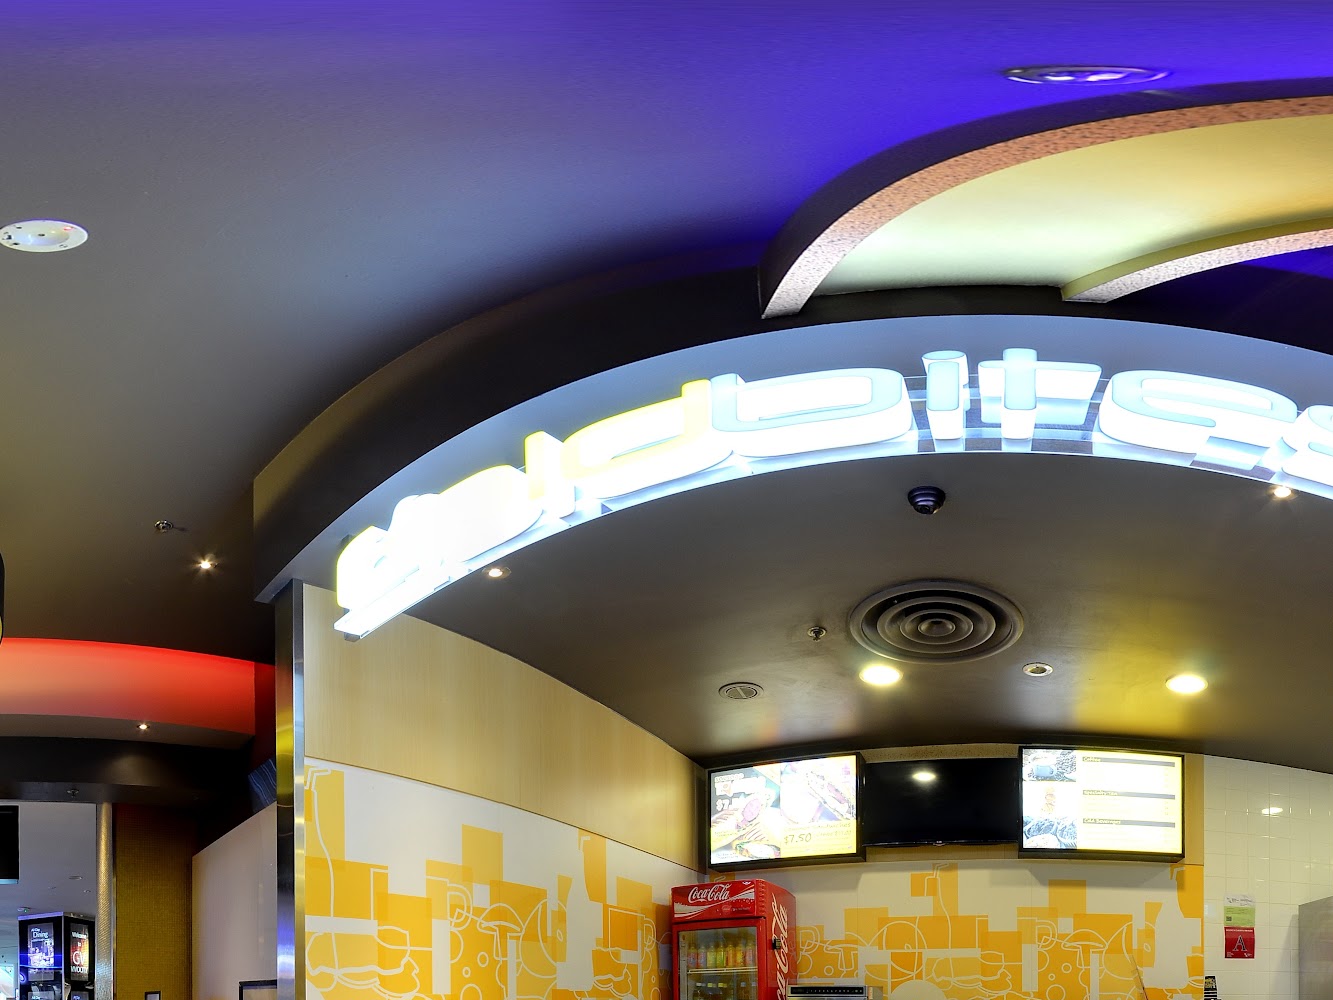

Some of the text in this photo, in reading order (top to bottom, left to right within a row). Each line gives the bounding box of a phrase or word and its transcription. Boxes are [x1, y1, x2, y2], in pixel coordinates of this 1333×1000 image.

[784, 833, 811, 844] $7.50
[688, 883, 731, 903] Coca-Cola
[1232, 935, 1247, 951] A
